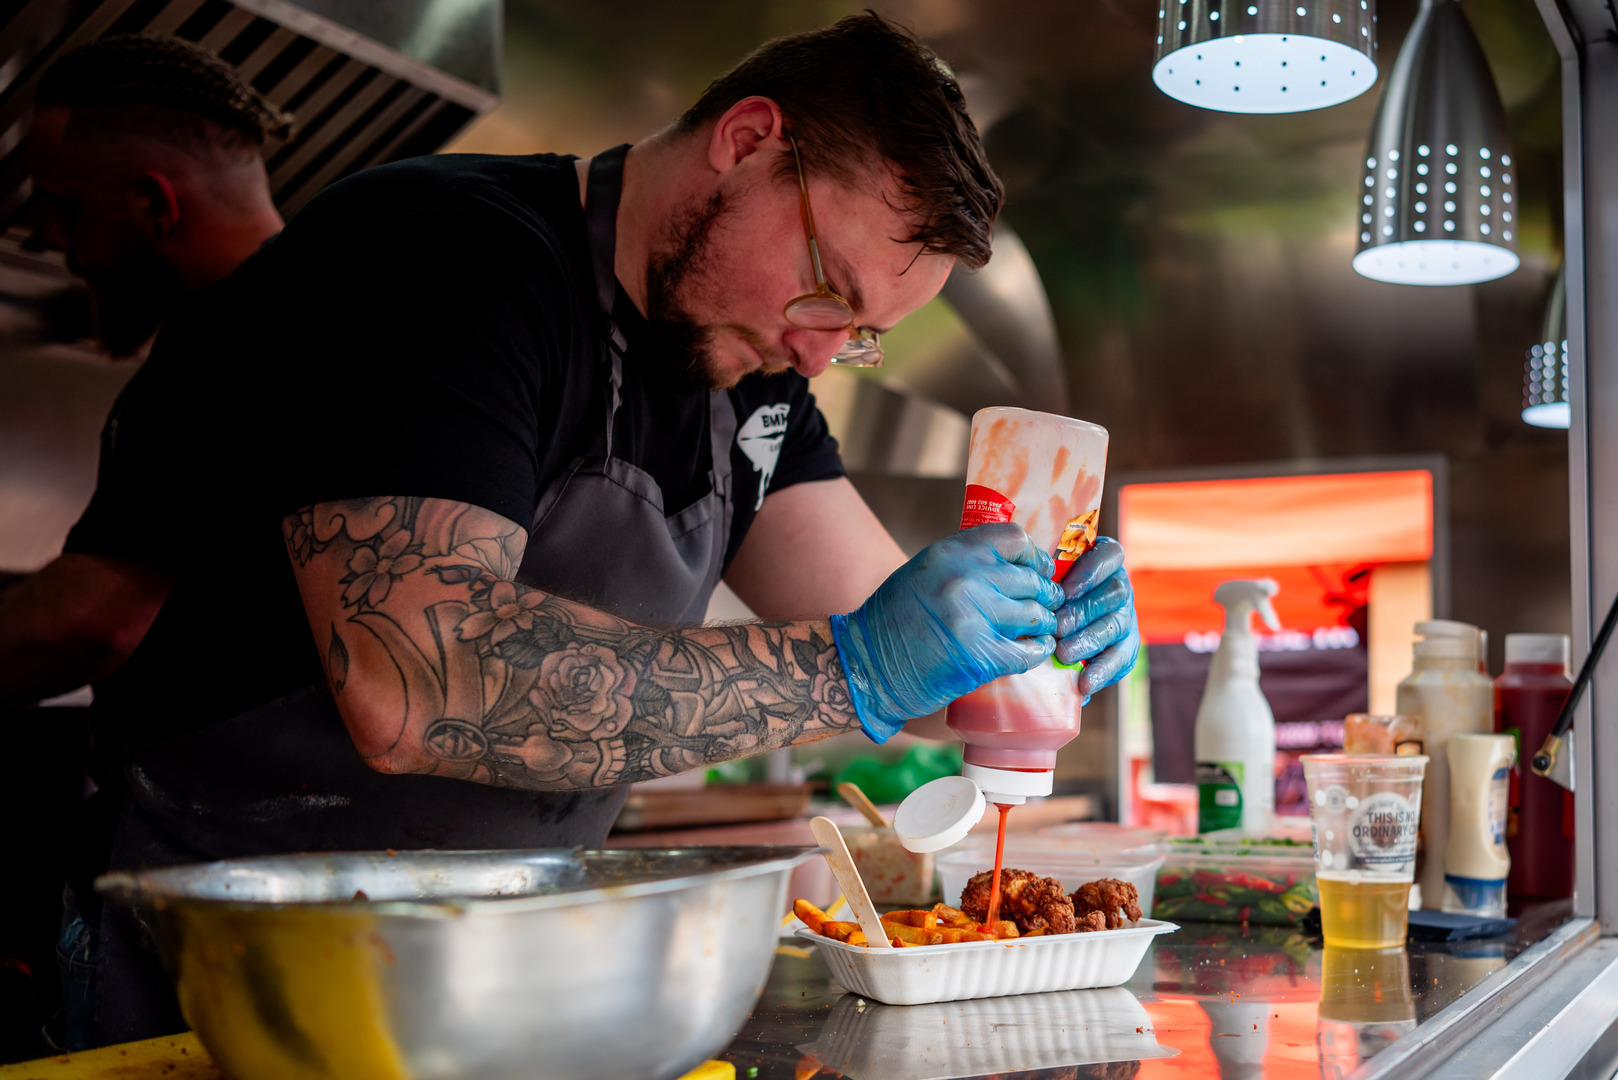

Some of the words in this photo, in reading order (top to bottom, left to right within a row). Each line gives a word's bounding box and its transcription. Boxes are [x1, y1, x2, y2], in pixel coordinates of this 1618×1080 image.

[978, 505, 1000, 513] ADVICE
[1367, 812, 1393, 824] THIS
[1395, 811, 1404, 823] IS
[1406, 811, 1415, 822] NO
[1352, 825, 1408, 838] ORDINARY
